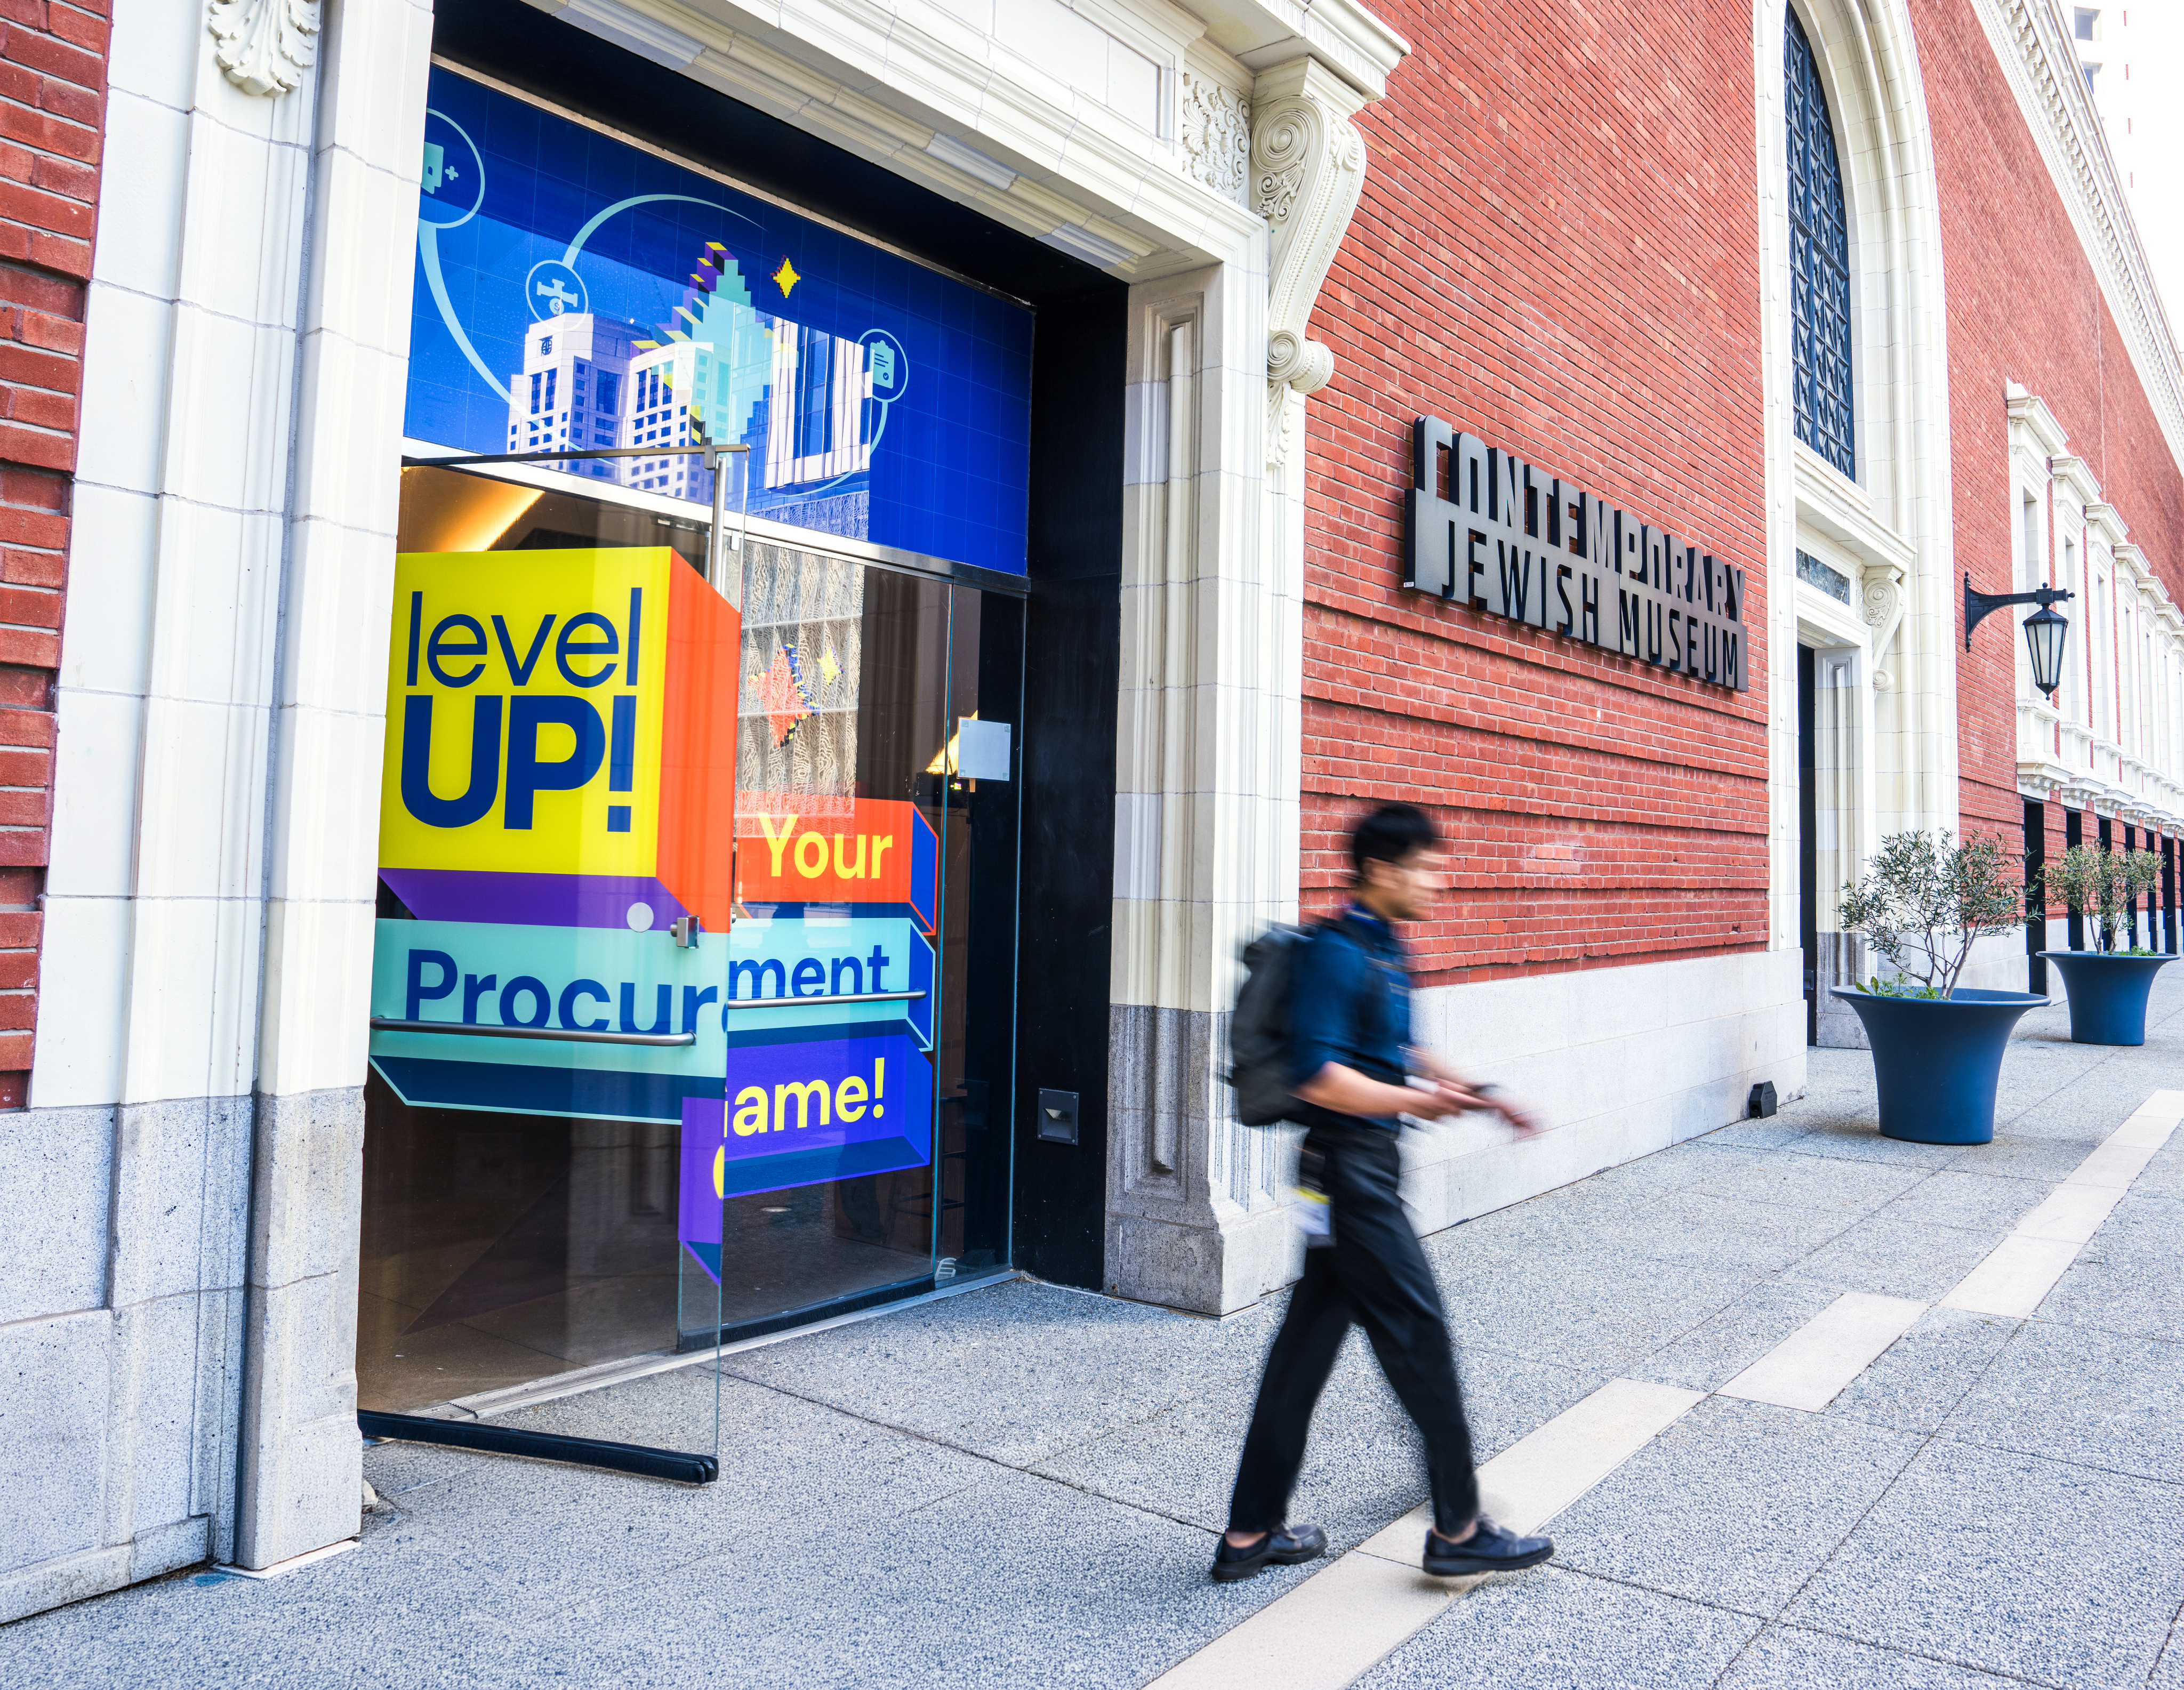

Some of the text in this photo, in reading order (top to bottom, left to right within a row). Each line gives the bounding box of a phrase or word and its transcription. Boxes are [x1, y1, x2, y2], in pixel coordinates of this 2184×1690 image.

[1414, 415, 1746, 622] CONTEMPORARY
[407, 587, 642, 688] level
[1441, 518, 1739, 690] JEWISH MUSEUM
[401, 695, 637, 833] UP!
[757, 812, 893, 880] Your
[406, 948, 727, 1046] Procur
[724, 1058, 885, 1138] ame!
